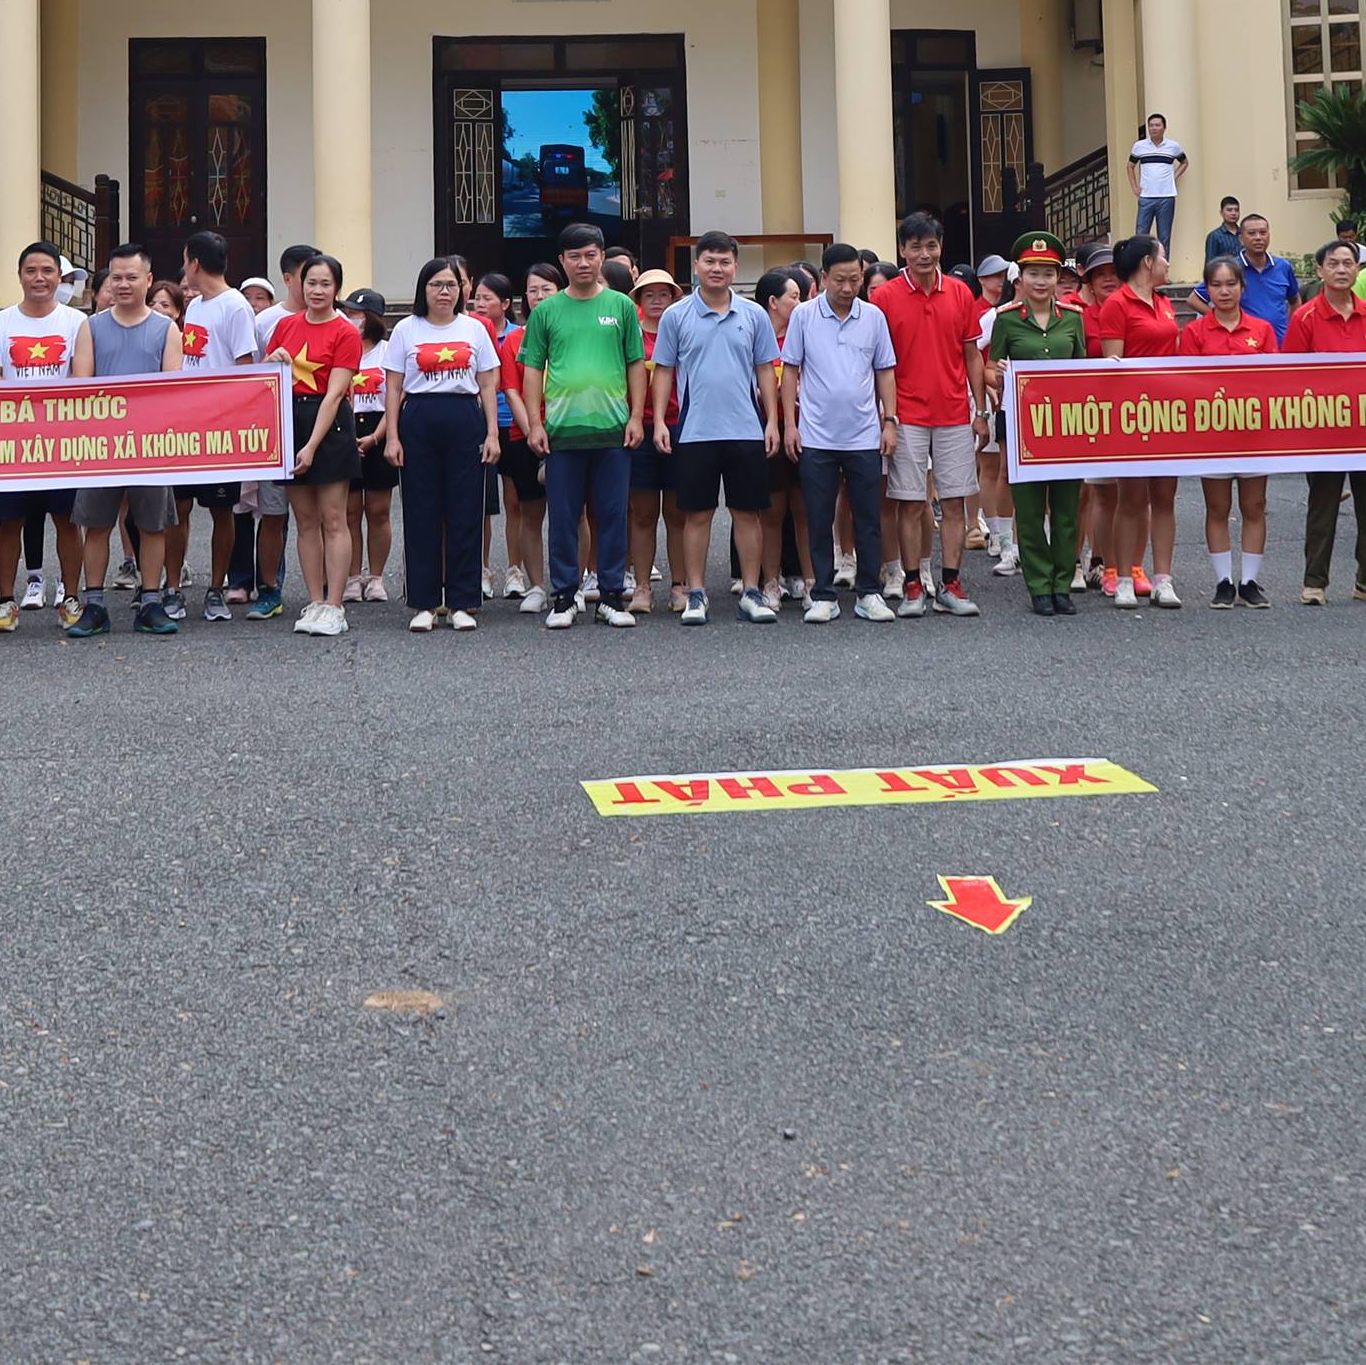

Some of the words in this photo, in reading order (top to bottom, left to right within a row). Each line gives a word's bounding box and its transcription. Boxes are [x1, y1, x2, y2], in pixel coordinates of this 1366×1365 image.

[0, 394, 35, 423] BÁ
[43, 390, 127, 422] THƯỚC
[1030, 396, 1053, 437] VÌ
[1060, 395, 1113, 443] MỘT
[1120, 393, 1187, 441] CỘNG
[1193, 387, 1261, 433] ĐỒNG
[1268, 388, 1351, 431] KHÔNG
[21, 434, 54, 463] XÂY
[60, 434, 108, 468] DỰNG
[113, 429, 137, 459] XÃ
[141, 427, 201, 458] KHÔNG
[206, 431, 234, 454] MA
[237, 423, 270, 453] TÚY
[611, 775, 848, 807] PHÁT
[877, 765, 1111, 799] XUẤT
